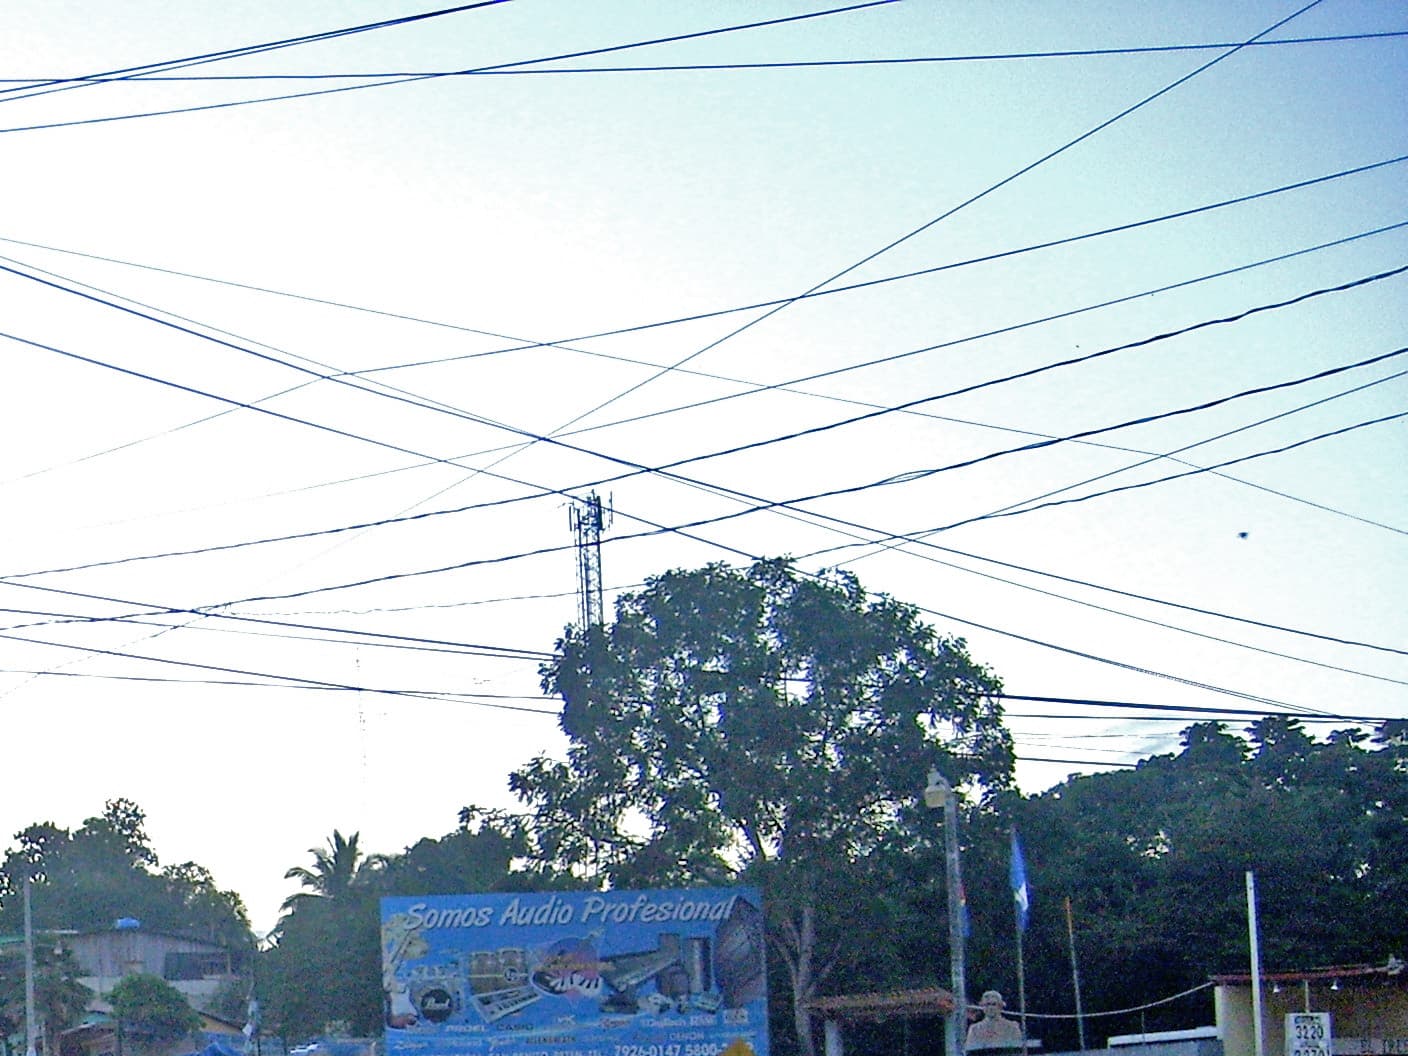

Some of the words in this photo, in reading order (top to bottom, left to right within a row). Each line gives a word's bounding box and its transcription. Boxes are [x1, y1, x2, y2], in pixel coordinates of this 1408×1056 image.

[403, 903, 494, 930] Somos
[499, 896, 574, 926] Audio
[581, 894, 736, 923] Profesional
